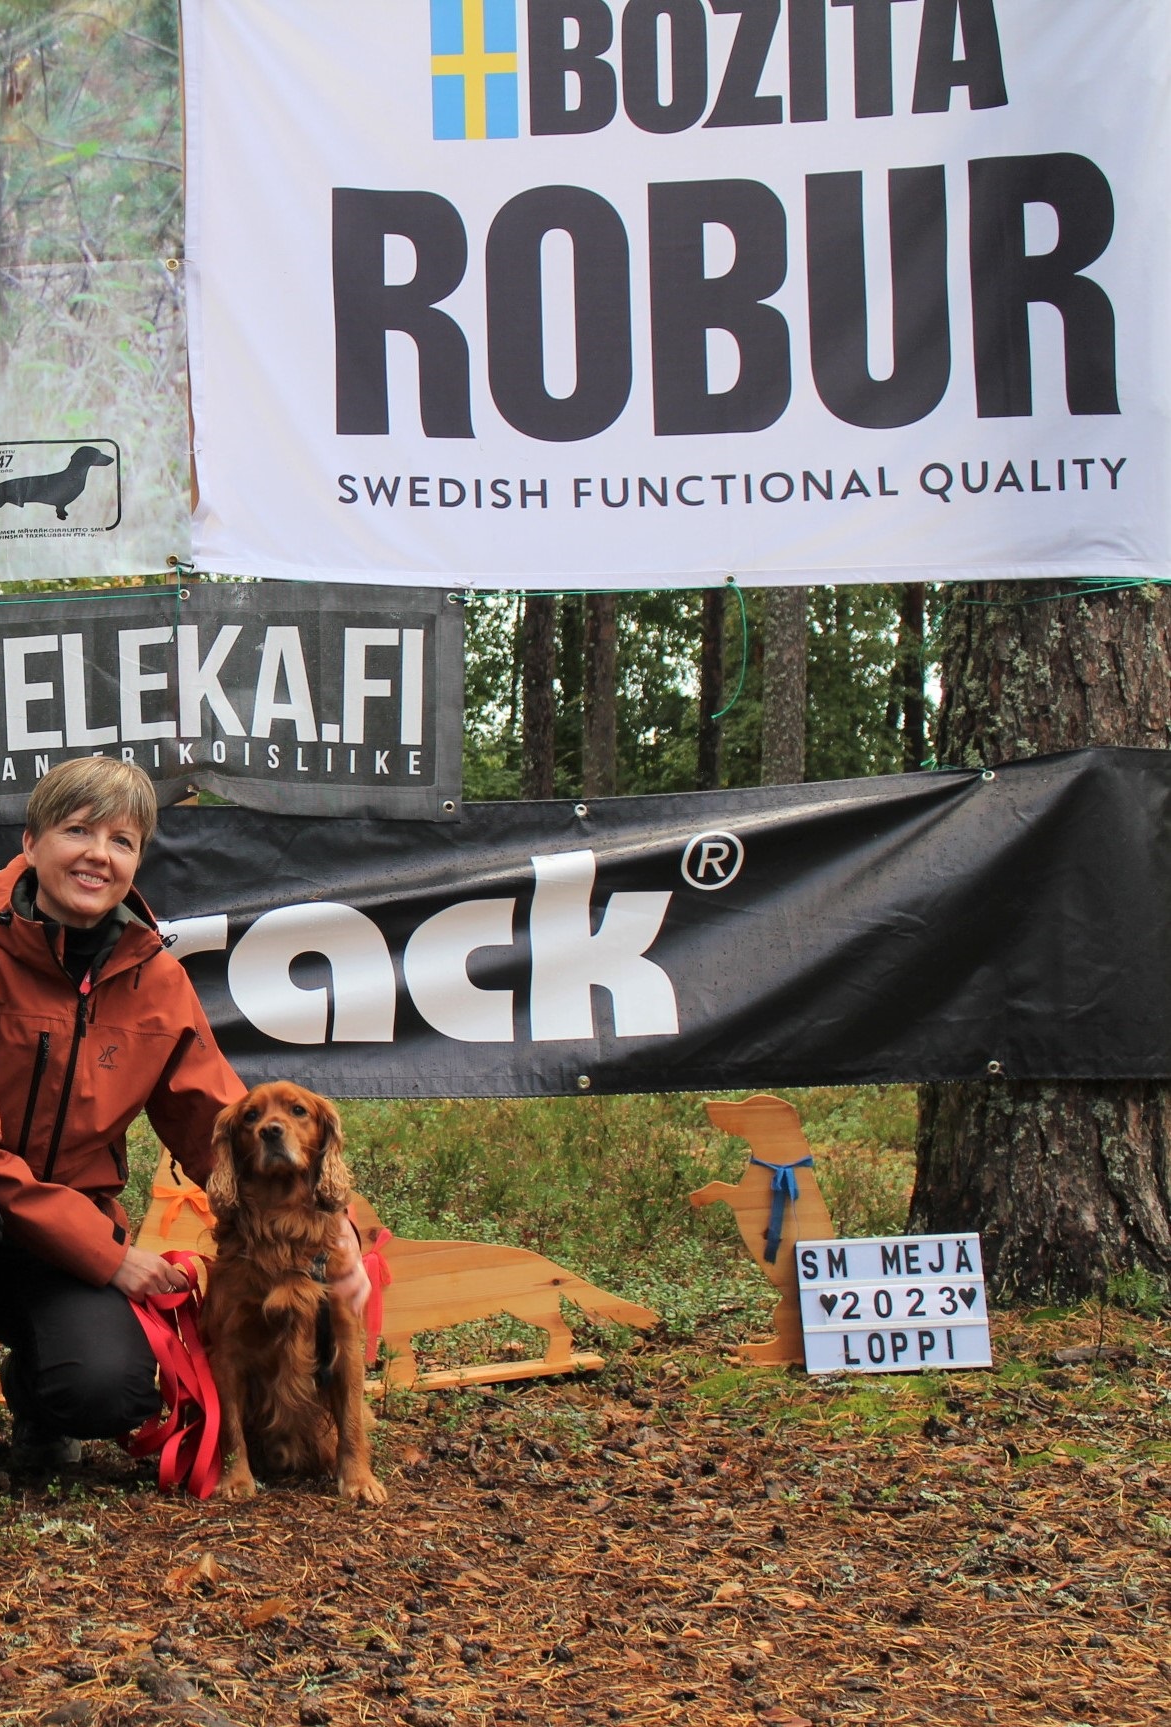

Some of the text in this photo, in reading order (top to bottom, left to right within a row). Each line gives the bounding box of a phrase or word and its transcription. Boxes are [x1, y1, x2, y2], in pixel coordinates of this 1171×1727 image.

[528, 0, 1009, 137] BOZITA
[332, 152, 1123, 443] ROBUR
[337, 457, 1128, 509] SWEDISH FUNCTIONAL QUALITY
[801, 1240, 974, 1280] SM MEJÄ
[840, 1286, 959, 1320] 2023
[842, 1329, 955, 1365] LOPPI
